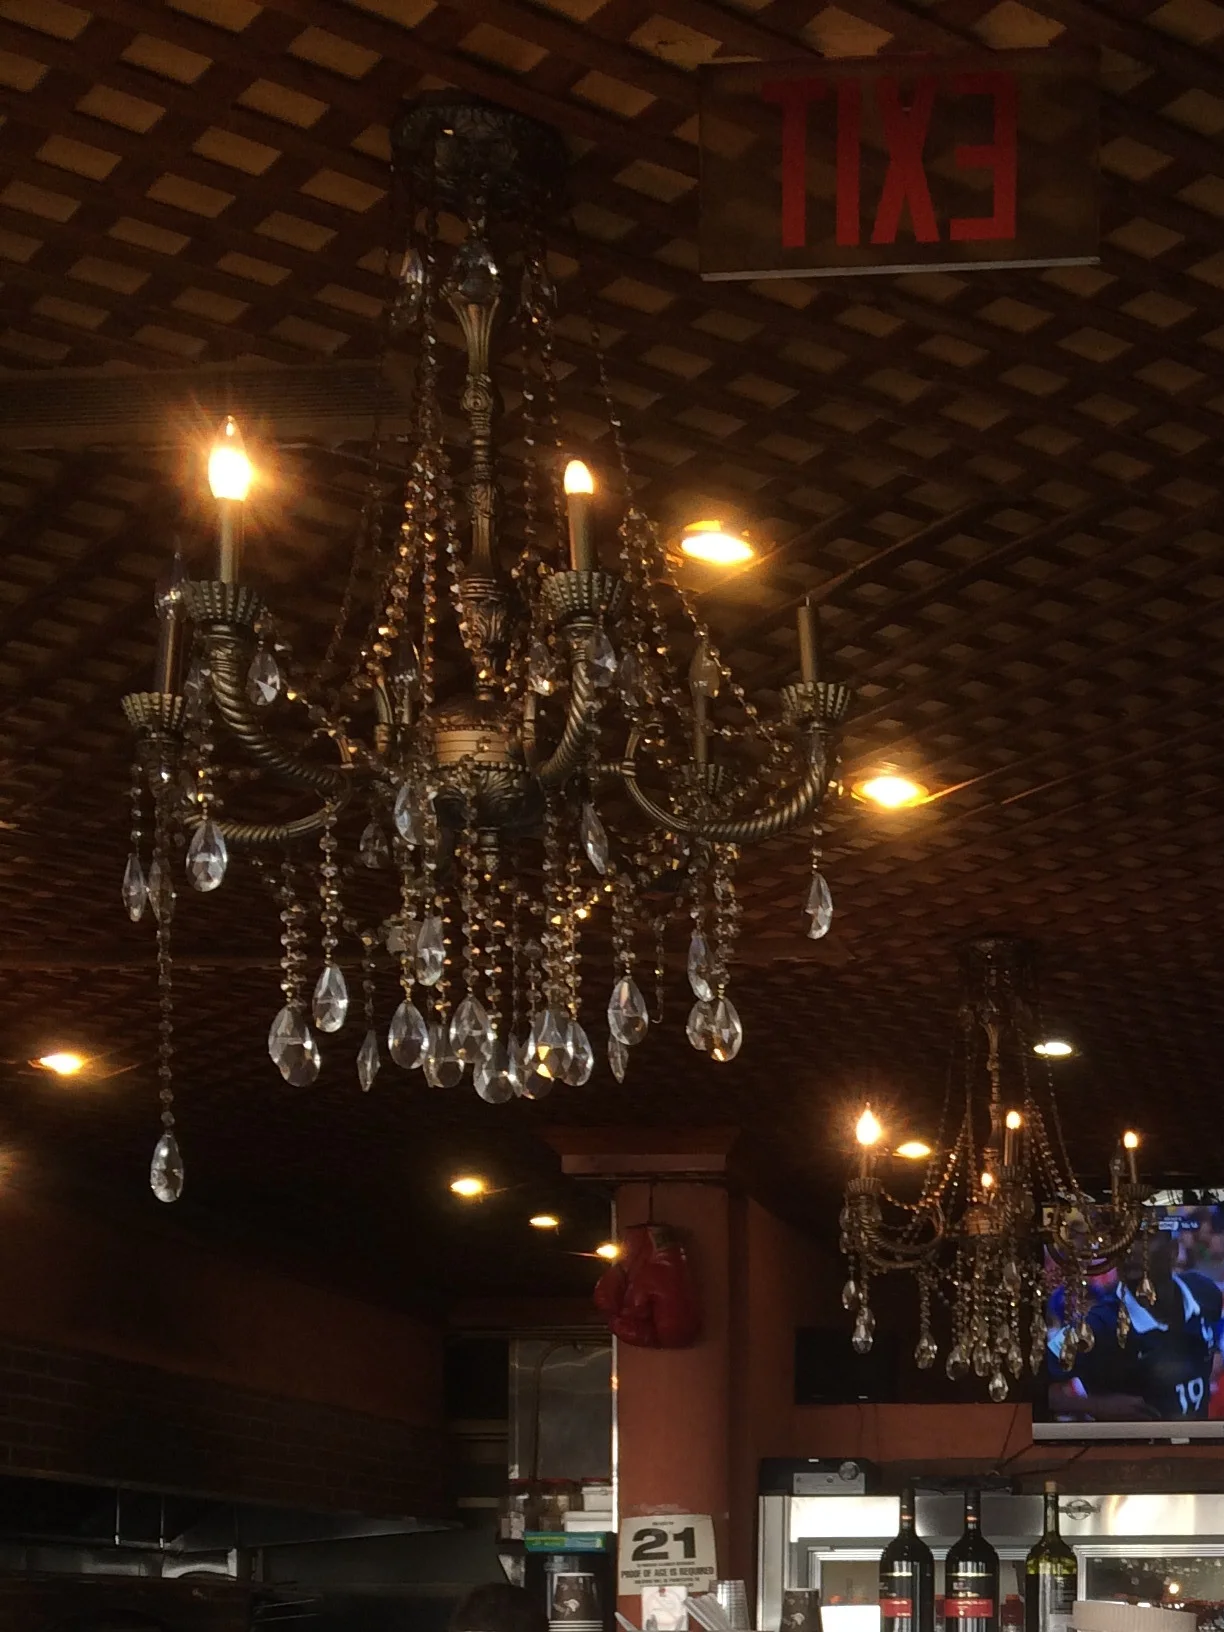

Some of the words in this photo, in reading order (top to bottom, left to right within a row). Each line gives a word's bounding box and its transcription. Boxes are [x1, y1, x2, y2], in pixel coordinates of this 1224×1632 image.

[1175, 1377, 1204, 1414] 19
[632, 1527, 697, 1561] 21
[621, 1570, 641, 1578] PROOF
[643, 1569, 651, 1577] OF
[654, 1568, 667, 1577] AGE
[670, 1568, 677, 1577] IS
[679, 1566, 714, 1577] REQUIRED
